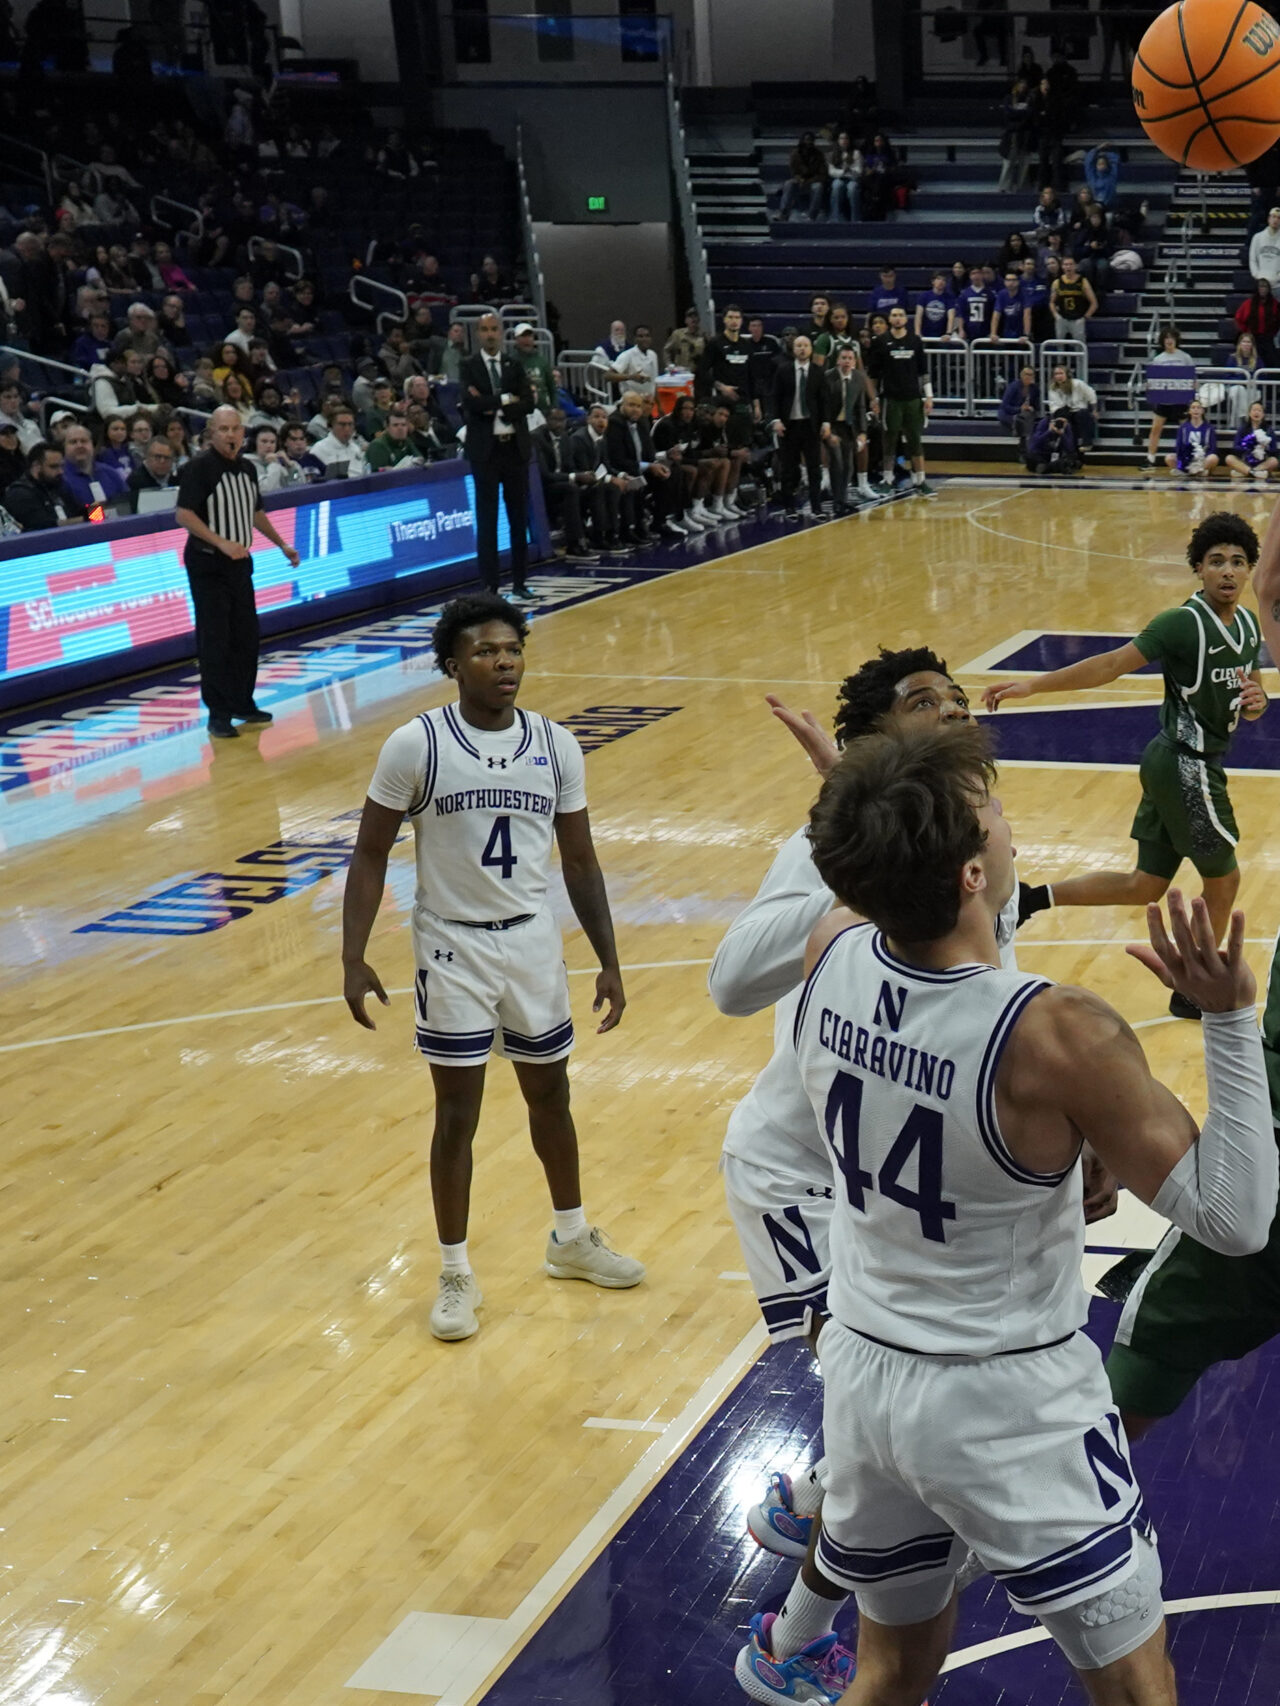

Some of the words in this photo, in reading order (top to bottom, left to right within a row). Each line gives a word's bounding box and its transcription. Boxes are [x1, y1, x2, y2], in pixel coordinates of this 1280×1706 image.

[392, 518, 437, 542] Therapy
[434, 788, 554, 817] NORTHWESTERN
[481, 816, 517, 879] 4
[873, 979, 909, 1033] N
[819, 1007, 956, 1101] CIARAVINO
[825, 1069, 957, 1244] 44
[762, 1205, 822, 1283] N
[1083, 1412, 1133, 1512] N
